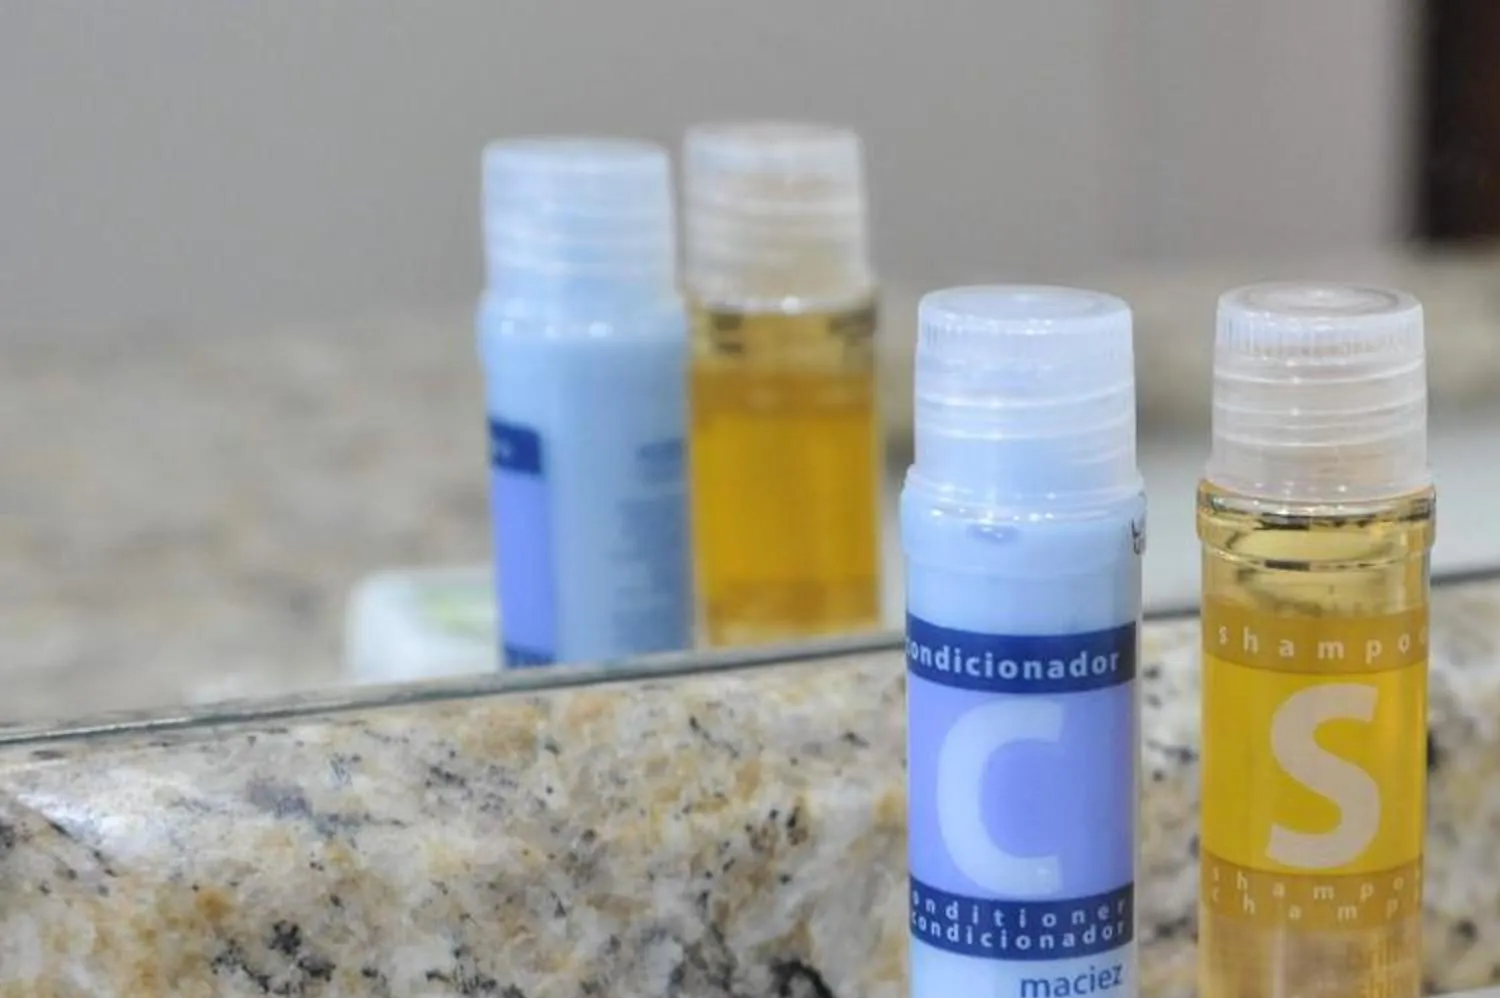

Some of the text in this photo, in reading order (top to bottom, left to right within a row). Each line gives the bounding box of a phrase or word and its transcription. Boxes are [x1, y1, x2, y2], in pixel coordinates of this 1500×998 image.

[936, 698, 1065, 896] C
[1265, 682, 1380, 868] S
[1020, 964, 1124, 998] maciez
